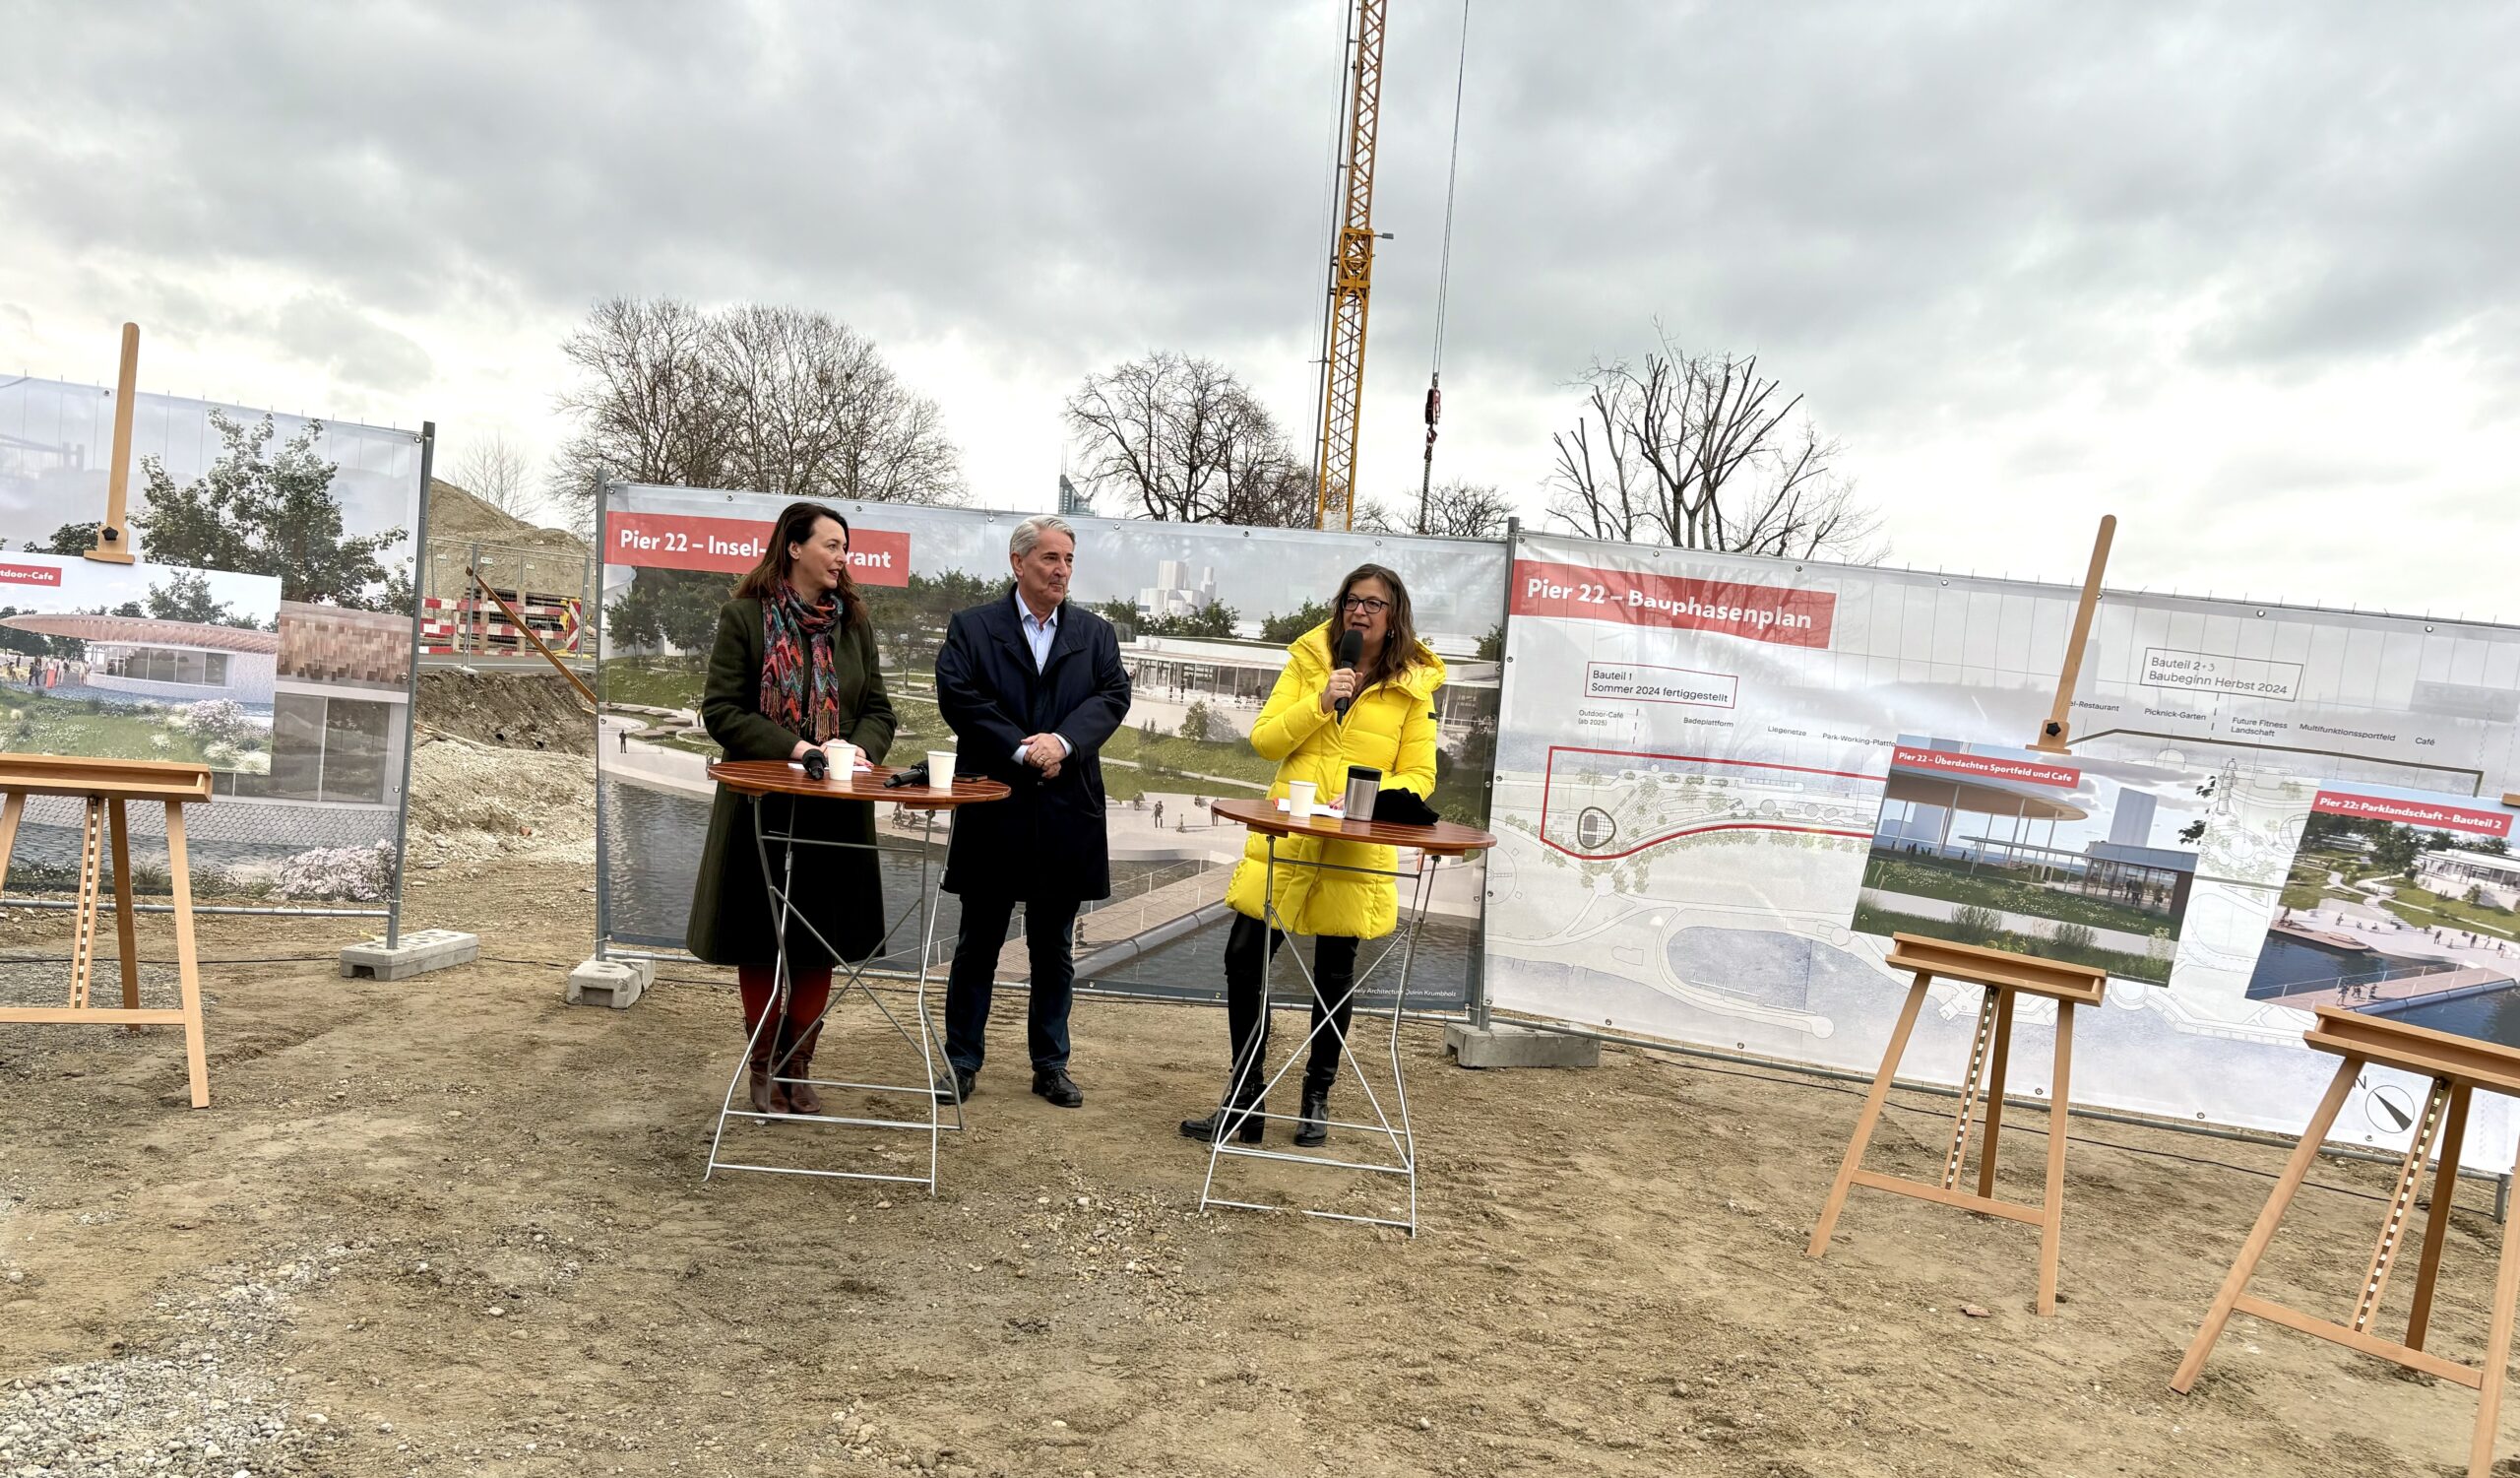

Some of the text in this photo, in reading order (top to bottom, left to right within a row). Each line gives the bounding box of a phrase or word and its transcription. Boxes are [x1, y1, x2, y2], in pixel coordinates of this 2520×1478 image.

[620, 529, 661, 550] Pier
[664, 532, 688, 552] 22
[0, 569, 54, 581] tdoor-Cafe
[1527, 578, 1573, 600] Pier
[1577, 583, 1606, 605] 22
[1627, 589, 1812, 629] Bauphasenplan
[2151, 657, 2191, 670] Bauteil
[1593, 670, 1626, 681] Bauteil
[2149, 671, 2288, 694] Baubeginn Herbst 2024
[1591, 682, 1729, 703] Sommer 2024 fertiggestellt
[2069, 700, 2119, 712] el-Restaurant
[2144, 708, 2207, 721] Picknick-Garten
[1682, 717, 1734, 728] Badeplattform
[2232, 717, 2288, 729] Future Fitness
[1767, 725, 1807, 737] Liegenetze
[2231, 726, 2276, 738] Landschaft
[2299, 723, 2396, 741] Multifunktionssportfeld
[1822, 733, 1896, 747] Park-Working-Plattfo
[2415, 737, 2435, 746] Café
[1898, 751, 1916, 761] Pier
[1917, 754, 1927, 763] 22
[1934, 753, 1988, 771] Überdachtes
[1989, 763, 2032, 777] Sportfeld
[2033, 770, 2049, 779] und
[2051, 772, 2072, 783] Cafe
[2318, 797, 2341, 807] Pier
[2342, 800, 2360, 810] 22:
[2361, 803, 2443, 821] Parklandschaft
[2452, 814, 2492, 828] Bauteil
[2493, 820, 2502, 829] 2
[1423, 989, 1457, 997] Krumbholz
